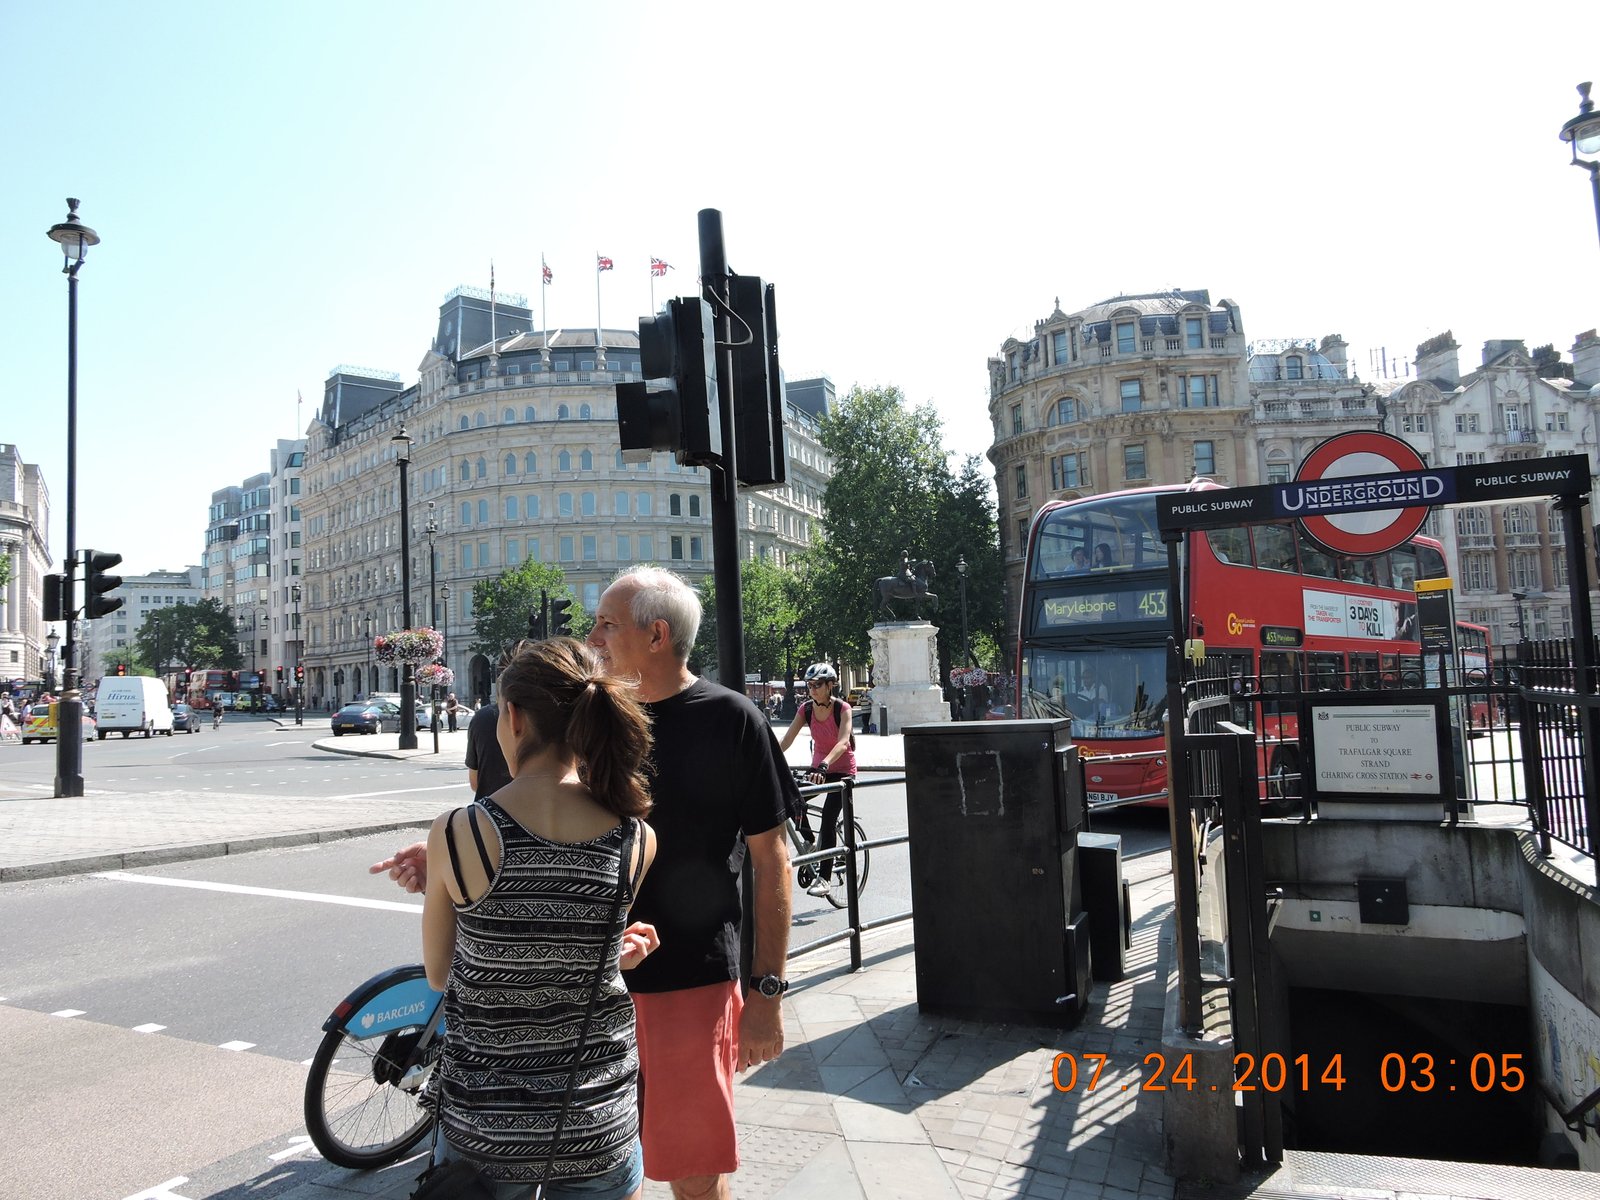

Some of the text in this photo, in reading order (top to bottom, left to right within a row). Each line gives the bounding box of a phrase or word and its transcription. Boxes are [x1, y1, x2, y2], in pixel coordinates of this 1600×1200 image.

[1475, 469, 1571, 487] PUBLIC SUBWAY
[1281, 475, 1444, 511] UNDERGROUND
[1171, 499, 1254, 515] PUBLIC SUBWAY
[1045, 591, 1167, 617] Marylebone 453
[1349, 606, 1379, 622] 3 DAYS
[1266, 631, 1277, 643] 453
[1358, 621, 1383, 637] TO KILL
[1345, 723, 1401, 732] PUBLIC SUBWAY
[1338, 748, 1412, 757] TRAFALGAR SQUARE
[1360, 760, 1391, 768] STRAND
[1321, 771, 1408, 780] CHARING CROSS STATION
[377, 1000, 425, 1023] BARCLAYS
